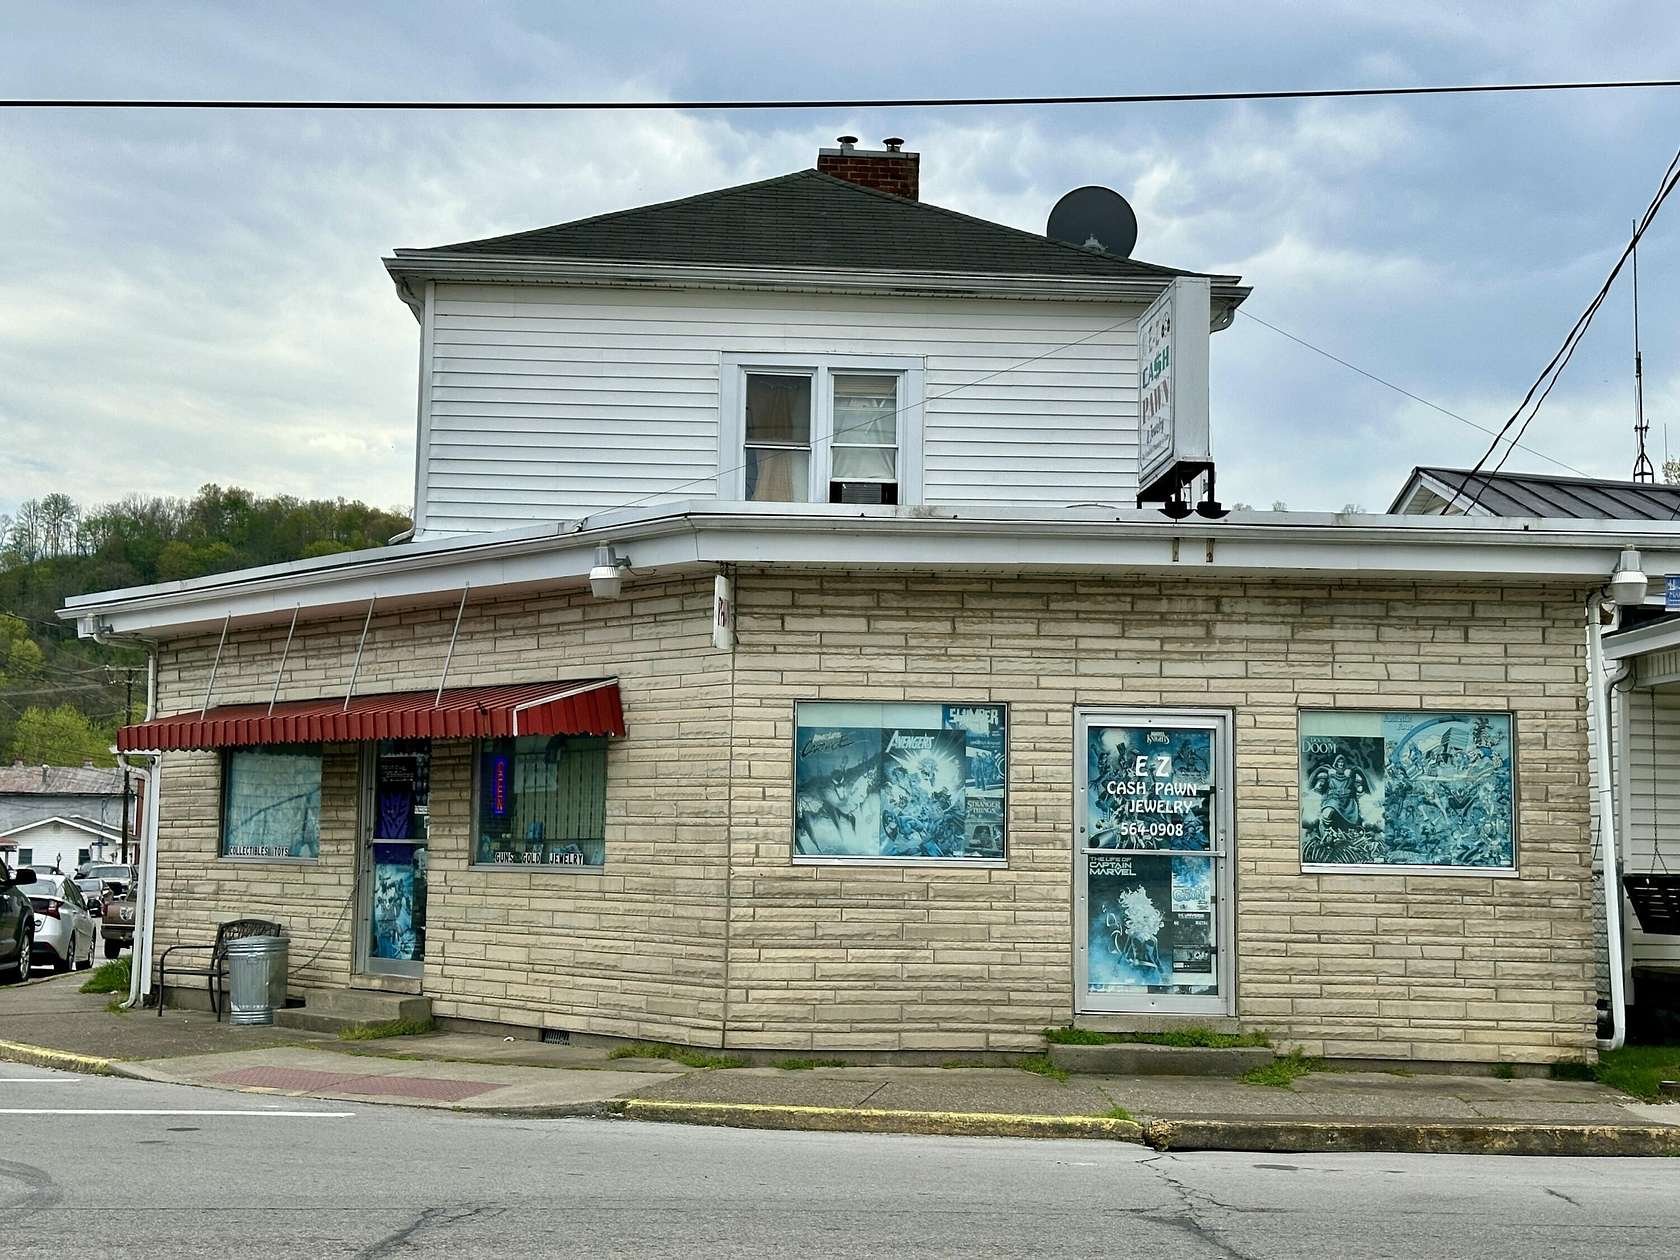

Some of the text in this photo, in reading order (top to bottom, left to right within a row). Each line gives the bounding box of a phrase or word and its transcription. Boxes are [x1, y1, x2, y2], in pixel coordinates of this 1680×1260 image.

[1142, 376, 1170, 425] PAWN
[1302, 740, 1337, 754] DOOM
[1136, 755, 1171, 777] E Z
[1107, 781, 1197, 796] CASH PAWN
[1129, 799, 1193, 814] JEWELRY
[1121, 822, 1184, 837] 564-0908
[228, 846, 269, 856] COLLECTIBLES
[495, 852, 584, 866] GUNS GOLD JEWELRY
[1089, 861, 1132, 869] CAPTAIN
[1089, 868, 1137, 876] MARVEL
